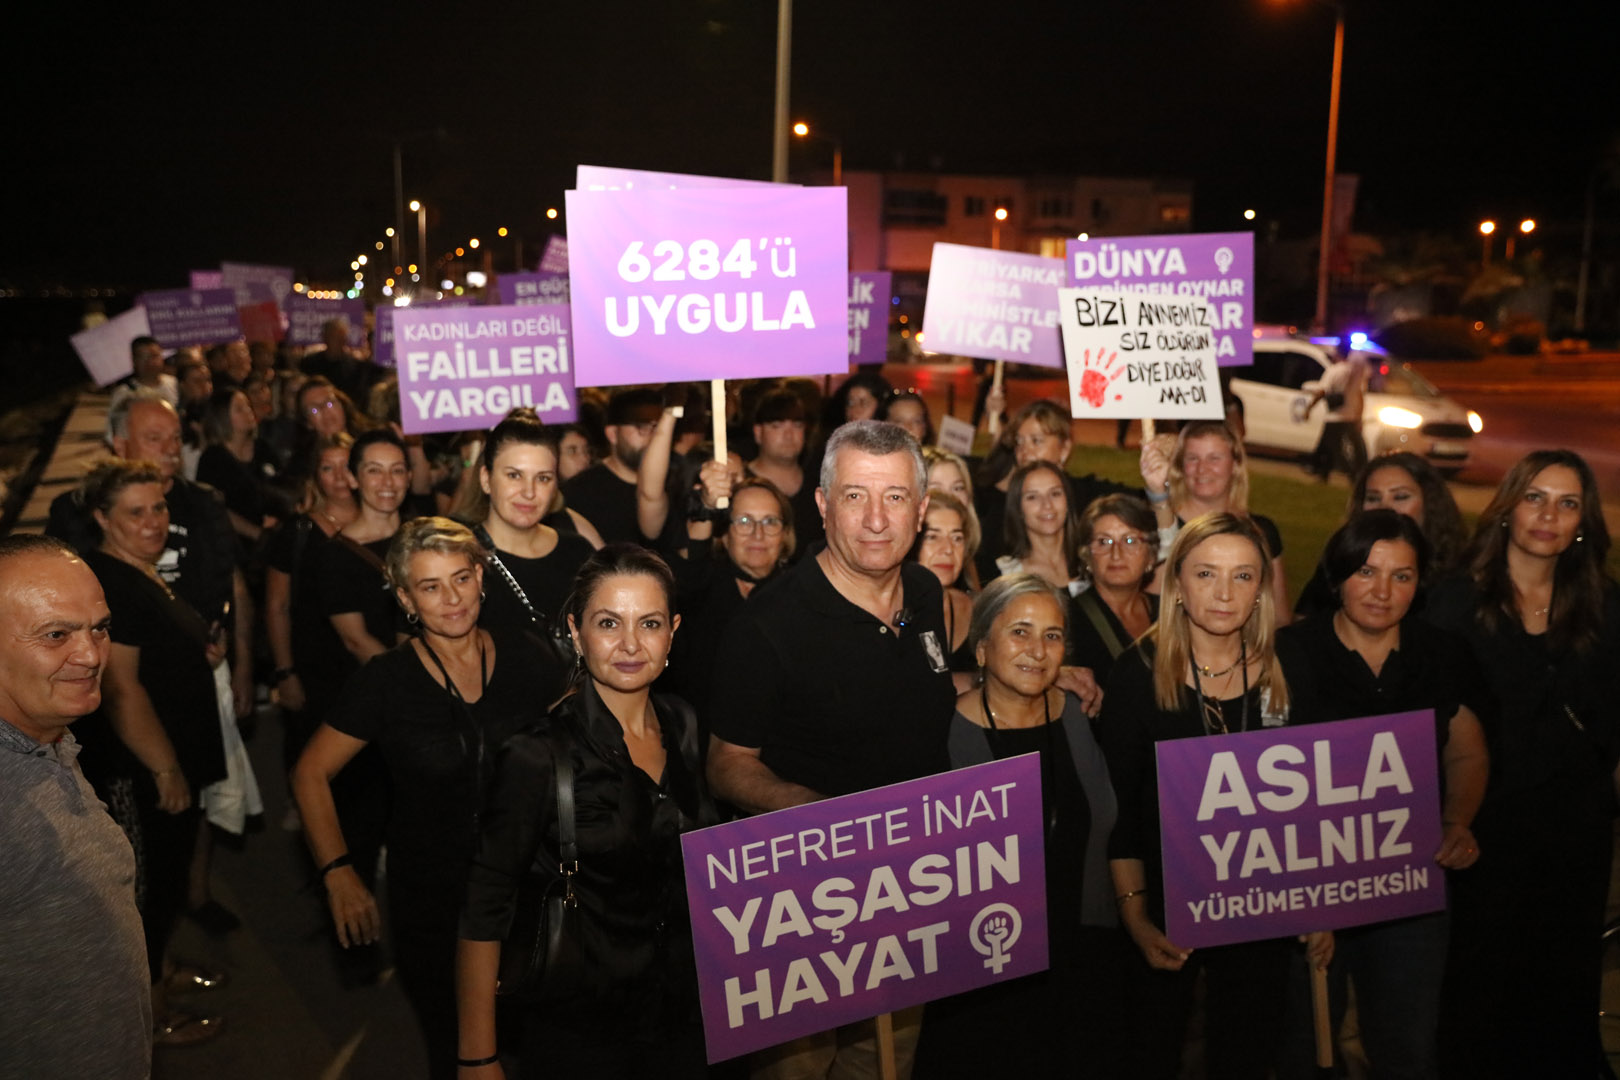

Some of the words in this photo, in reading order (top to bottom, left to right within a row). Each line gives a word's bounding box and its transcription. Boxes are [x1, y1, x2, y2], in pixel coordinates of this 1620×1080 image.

[1074, 243, 1187, 280] DÜNYA
[403, 320, 508, 342] KADINLARI
[511, 314, 568, 338] DEĞİL
[604, 290, 816, 337] UYGULA
[934, 316, 1033, 354] YIKAR
[1075, 297, 1127, 327] BİZİ
[1138, 302, 1210, 327] ANNEMİZ
[406, 336, 570, 383] FAİLLERİ
[1156, 330, 1210, 351] ÖLDÜRÜN
[409, 381, 571, 421] YARGILA
[1196, 731, 1415, 822] ASLA
[706, 807, 911, 890] NEFRETE
[922, 782, 1017, 837] İNAT
[1199, 807, 1413, 882] YALNIZ
[712, 834, 1021, 955] YAŞASIN
[1187, 864, 1429, 923] YÜRÜMEYECEKSİN
[724, 920, 950, 1029] HAYAT
